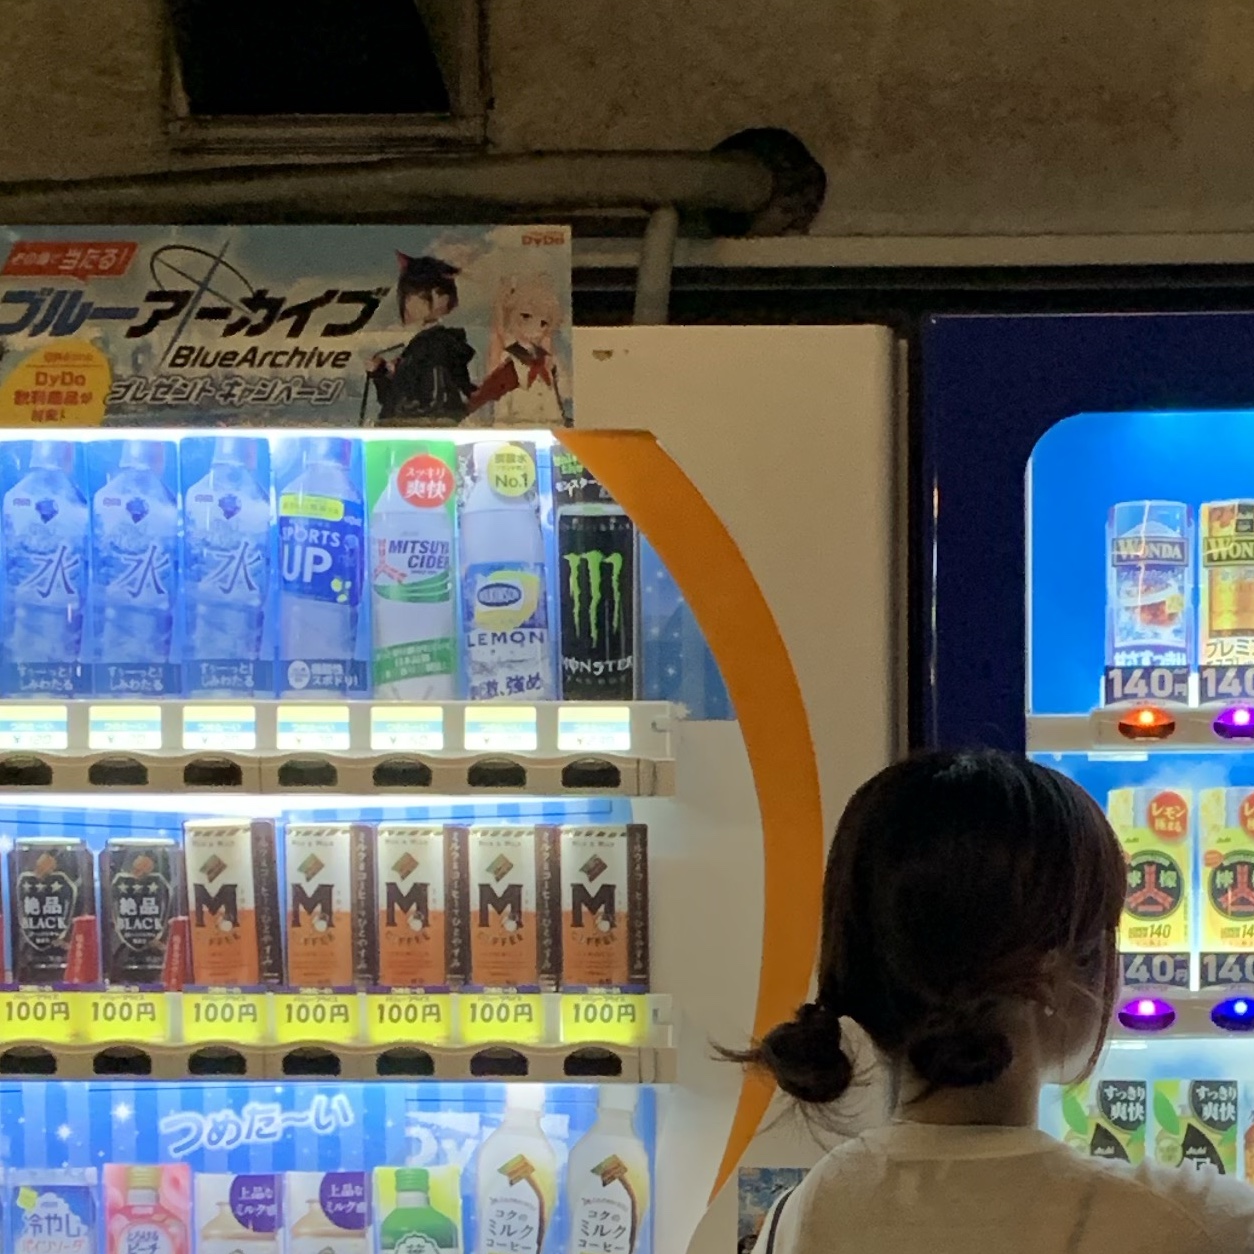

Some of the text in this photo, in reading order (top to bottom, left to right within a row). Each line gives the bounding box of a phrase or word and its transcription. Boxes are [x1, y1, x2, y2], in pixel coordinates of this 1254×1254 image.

[0, 286, 390, 338] ブルーアーカイブ
[168, 346, 351, 369] BlueArchive
[35, 371, 86, 387] DyDo
[405, 481, 446, 499] 爽快
[495, 474, 528, 488] No.1
[281, 526, 341, 548] SPORTS
[282, 546, 333, 583] UP
[467, 632, 545, 647] LEMON
[1152, 803, 1186, 820] レモン
[24, 896, 64, 915] 絶品
[119, 896, 160, 915] 絶品
[22, 917, 66, 930] BLACK
[118, 917, 162, 930] BLACK
[6, 1002, 70, 1021] 100円
[91, 1002, 155, 1021] 100円
[194, 1003, 257, 1023] 100円
[285, 1003, 349, 1023] 100円
[377, 1003, 441, 1023] 100円
[470, 1003, 533, 1023] 100円
[574, 1003, 636, 1023] 100円
[1104, 1084, 1146, 1102] すっきり
[1196, 1084, 1238, 1102] すっきり
[1110, 1102, 1145, 1121] 爽快
[1202, 1102, 1237, 1122] 爽快
[24, 1214, 80, 1236] 冷やし
[489, 1220, 534, 1241] ミルク
[581, 1220, 627, 1241] ミルク
[486, 1239, 532, 1252] コーヒー
[578, 1239, 624, 1252] コーヒー
